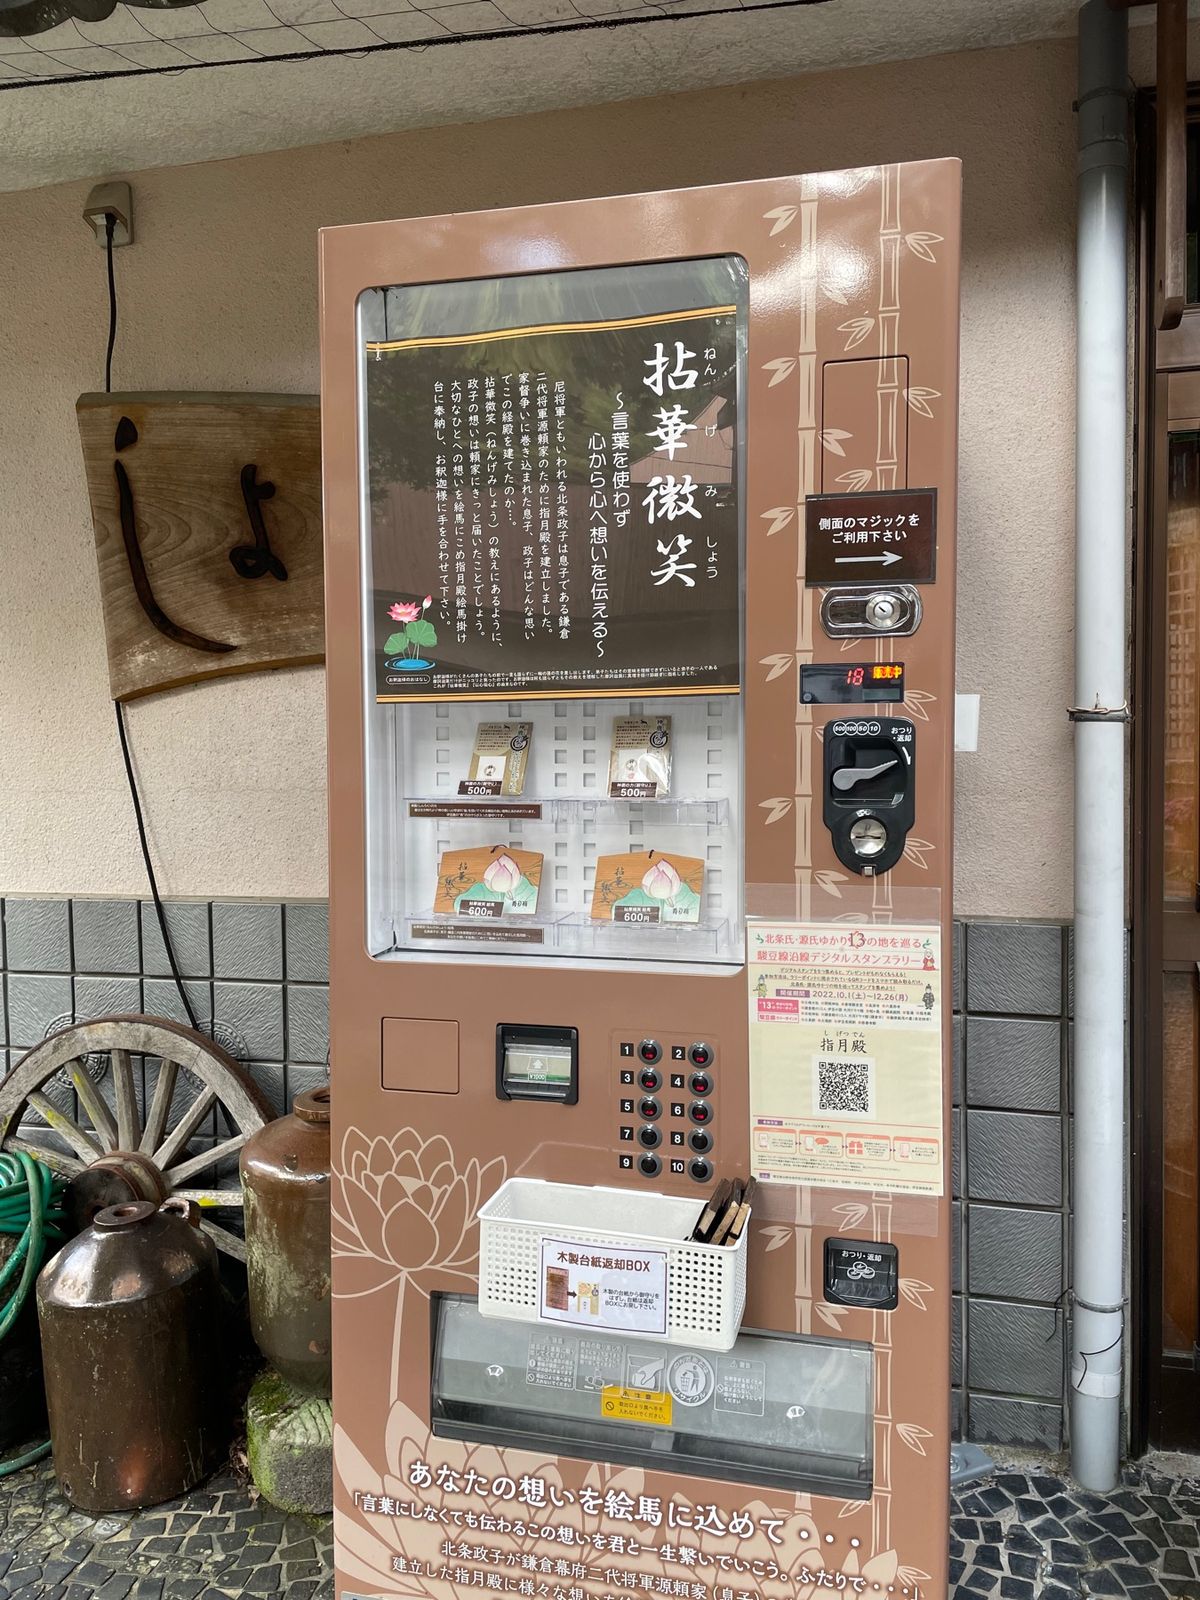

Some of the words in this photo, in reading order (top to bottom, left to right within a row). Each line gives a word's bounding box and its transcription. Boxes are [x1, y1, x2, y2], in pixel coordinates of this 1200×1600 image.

[703, 347, 717, 376] ねん
[704, 425, 716, 438] げ
[641, 341, 702, 588] 拈華微笑
[704, 485, 718, 497] み
[467, 378, 486, 636] 政子の想いは頼家にきっと届いたことでしょう。
[536, 372, 553, 633] 二代将軍源頼家のために指月殿を建立しました。
[554, 380, 571, 640] 尼将軍ともいわれる北条政子は息子である鎌倉
[450, 380, 467, 643] 大切なひとへの想いを絵馬にこめ指月殿絵馬掛け
[818, 513, 920, 531] 側面のマジックを
[831, 529, 908, 544] ご利用下さい
[705, 536, 719, 580] しょう
[890, 727, 912, 735] おつり
[624, 1046, 629, 1055] 1
[675, 1049, 682, 1058] 2
[820, 1037, 868, 1054] 指月殿
[624, 1073, 631, 1083] 3
[674, 1077, 681, 1086] 4
[624, 1102, 631, 1111] 5
[674, 1106, 681, 1115] 6
[624, 1129, 630, 1138] 7
[674, 1134, 681, 1144] 8
[623, 1158, 630, 1167] 9
[672, 1162, 684, 1172] 10
[556, 1250, 651, 1272] 木製台紙返却BOX
